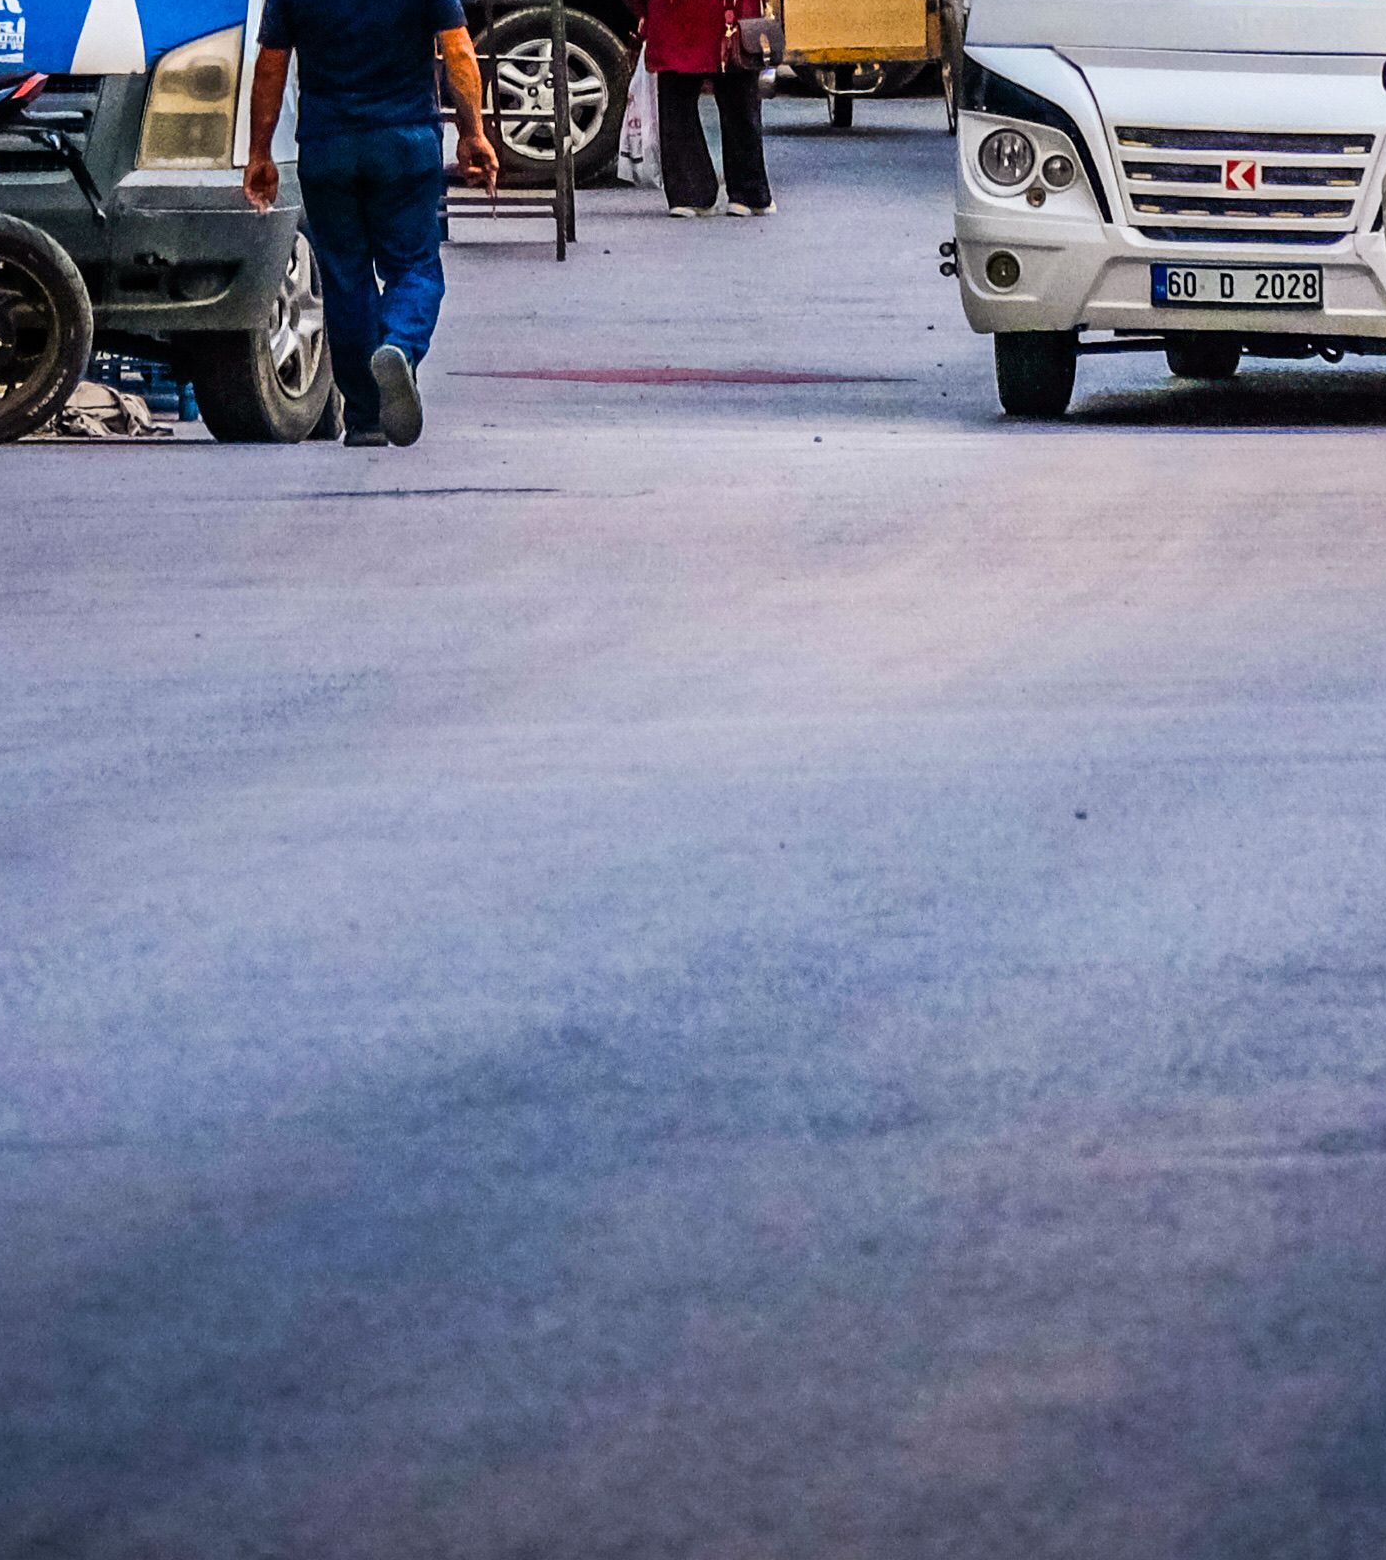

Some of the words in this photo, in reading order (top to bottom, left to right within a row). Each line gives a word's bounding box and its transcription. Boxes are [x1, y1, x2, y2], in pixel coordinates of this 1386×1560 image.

[1168, 271, 1197, 298] 60
[1220, 272, 1234, 299] D
[1255, 273, 1317, 300] 2028
